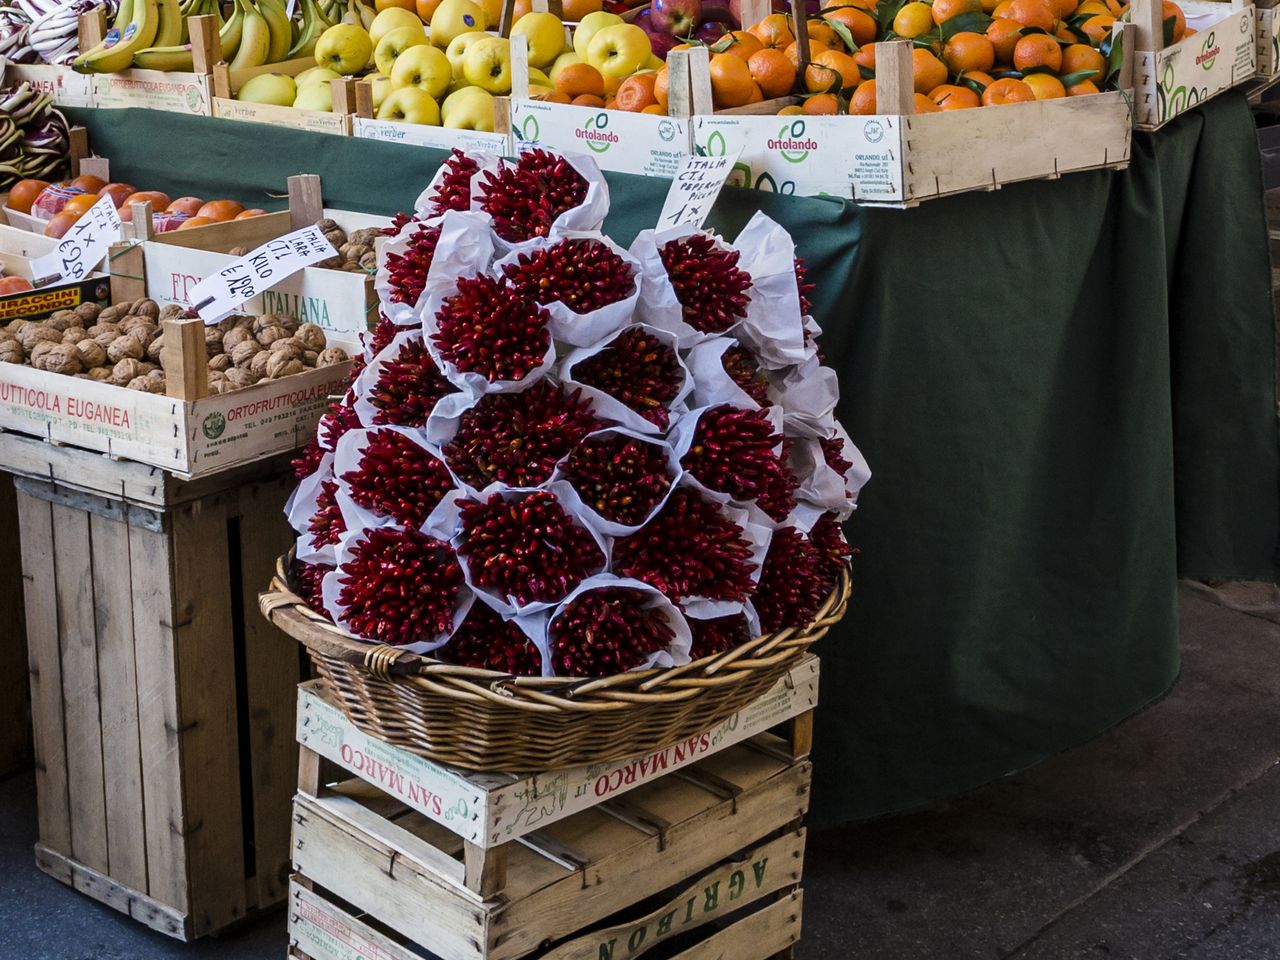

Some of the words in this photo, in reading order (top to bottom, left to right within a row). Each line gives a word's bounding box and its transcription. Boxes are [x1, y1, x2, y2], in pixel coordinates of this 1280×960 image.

[1195, 45, 1221, 66] Ortolando
[575, 128, 619, 143] Ortolando
[767, 139, 818, 151] Ortolando
[687, 157, 727, 169] ITALIA
[102, 201, 121, 231] ITALIA
[288, 239, 311, 257] LARA
[302, 228, 328, 253] ITALIA
[248, 251, 274, 280] KILO
[260, 289, 332, 328] ITALIANA
[67, 397, 131, 429] EUGANEA
[227, 386, 316, 422] ORTOFRUTTICOLA
[244, 422, 260, 430] TEL.
[672, 731, 711, 766] SAN
[341, 743, 404, 796] MARCO
[594, 754, 668, 798] MARCO
[407, 781, 443, 816] SAN
